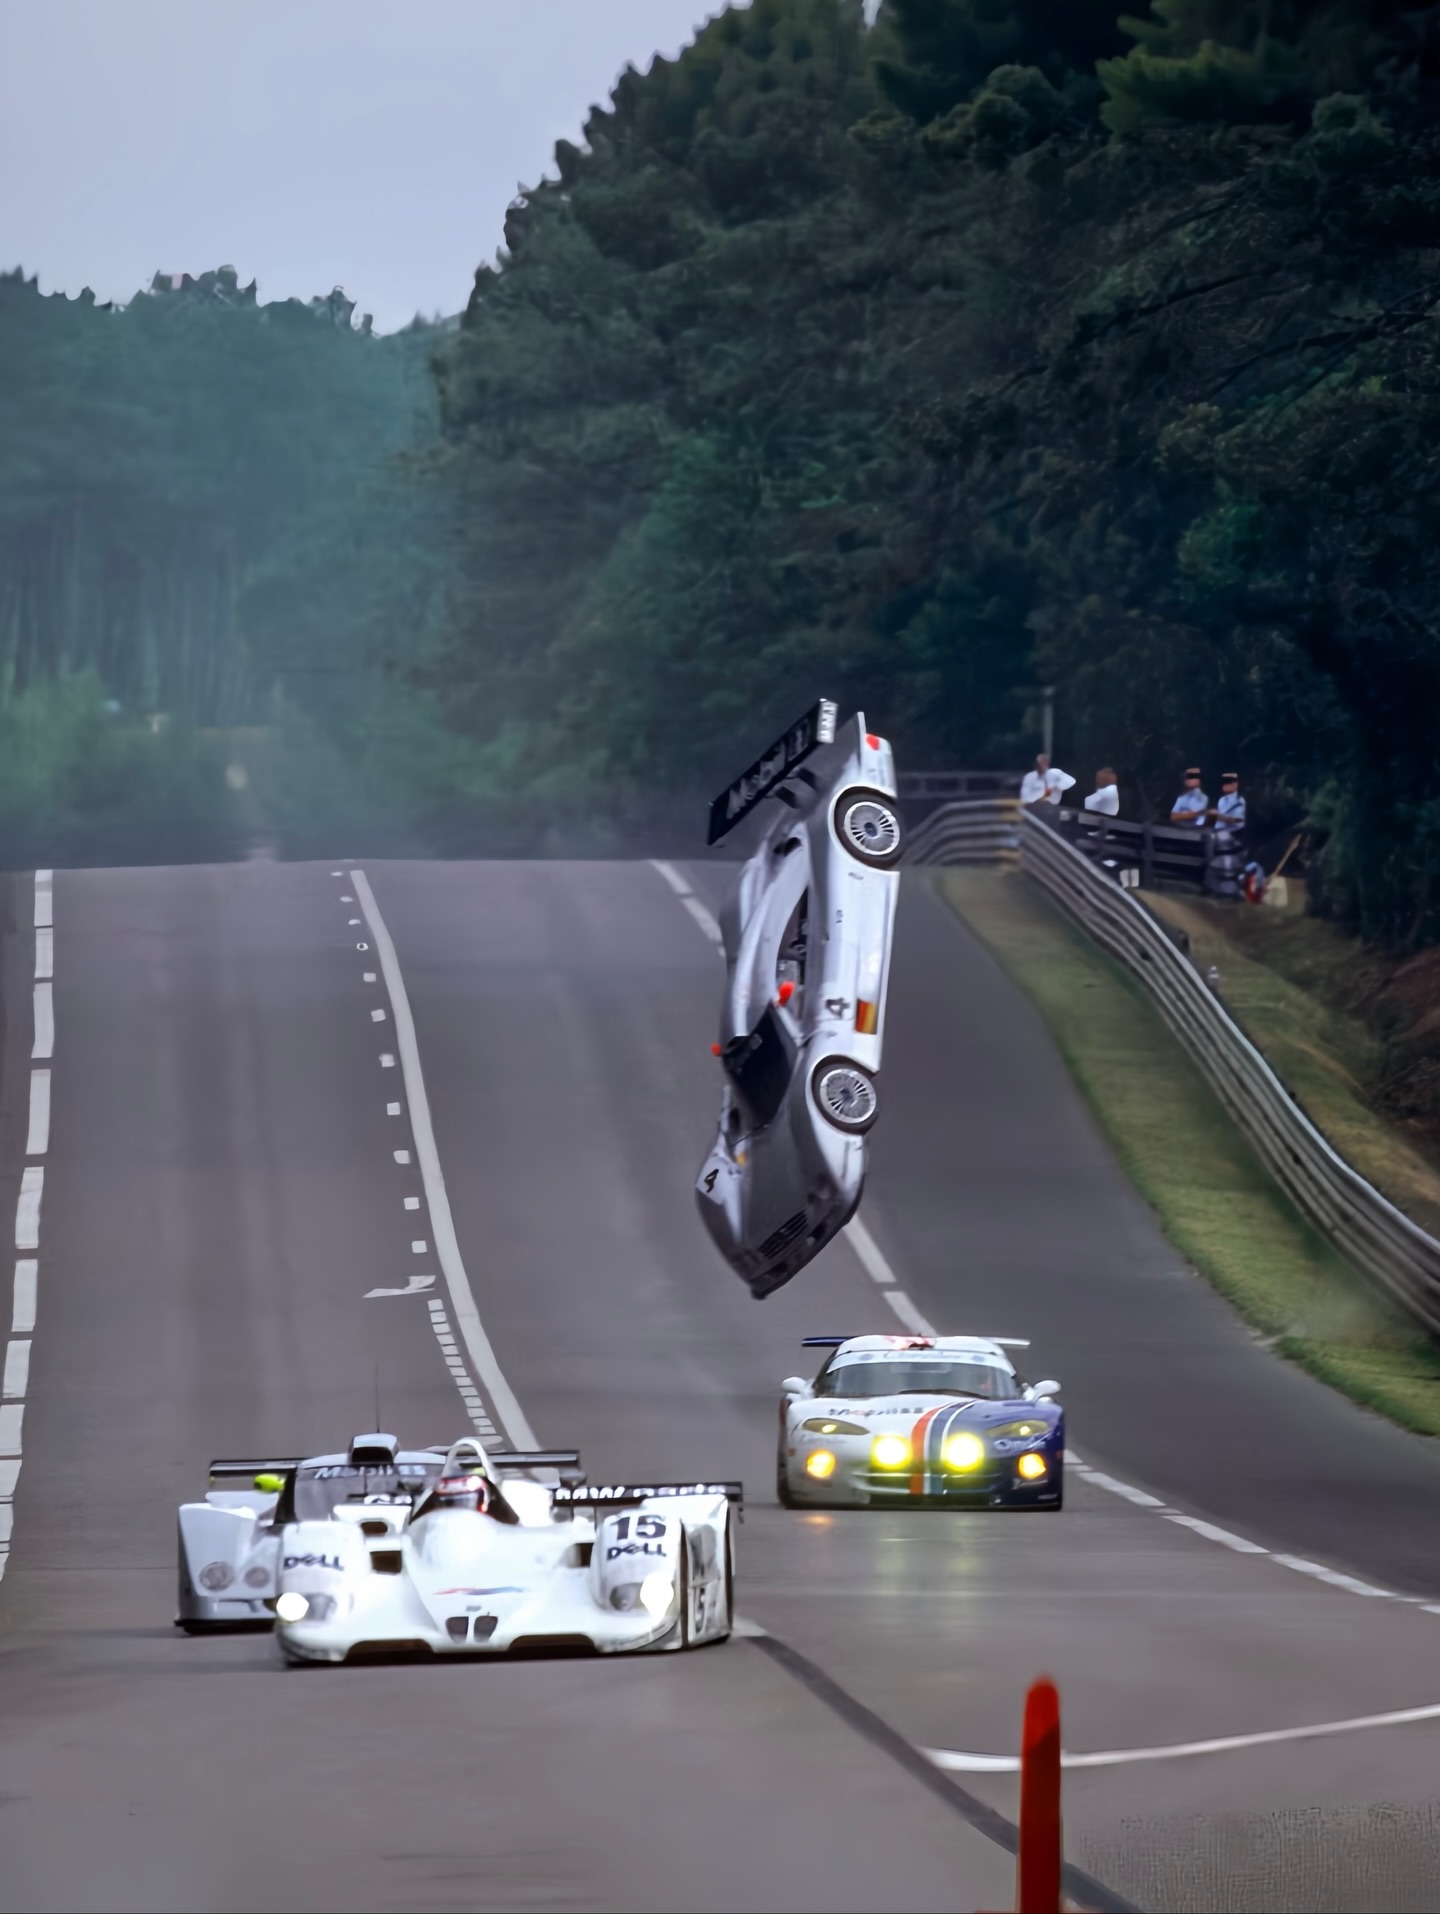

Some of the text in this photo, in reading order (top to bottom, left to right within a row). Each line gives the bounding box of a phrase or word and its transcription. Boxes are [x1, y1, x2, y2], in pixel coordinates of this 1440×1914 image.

[825, 997, 851, 1020] 4
[704, 1168, 720, 1194] 4
[608, 1514, 667, 1541] 15
[283, 1552, 345, 1572] DELL
[605, 1542, 667, 1561] DELL
